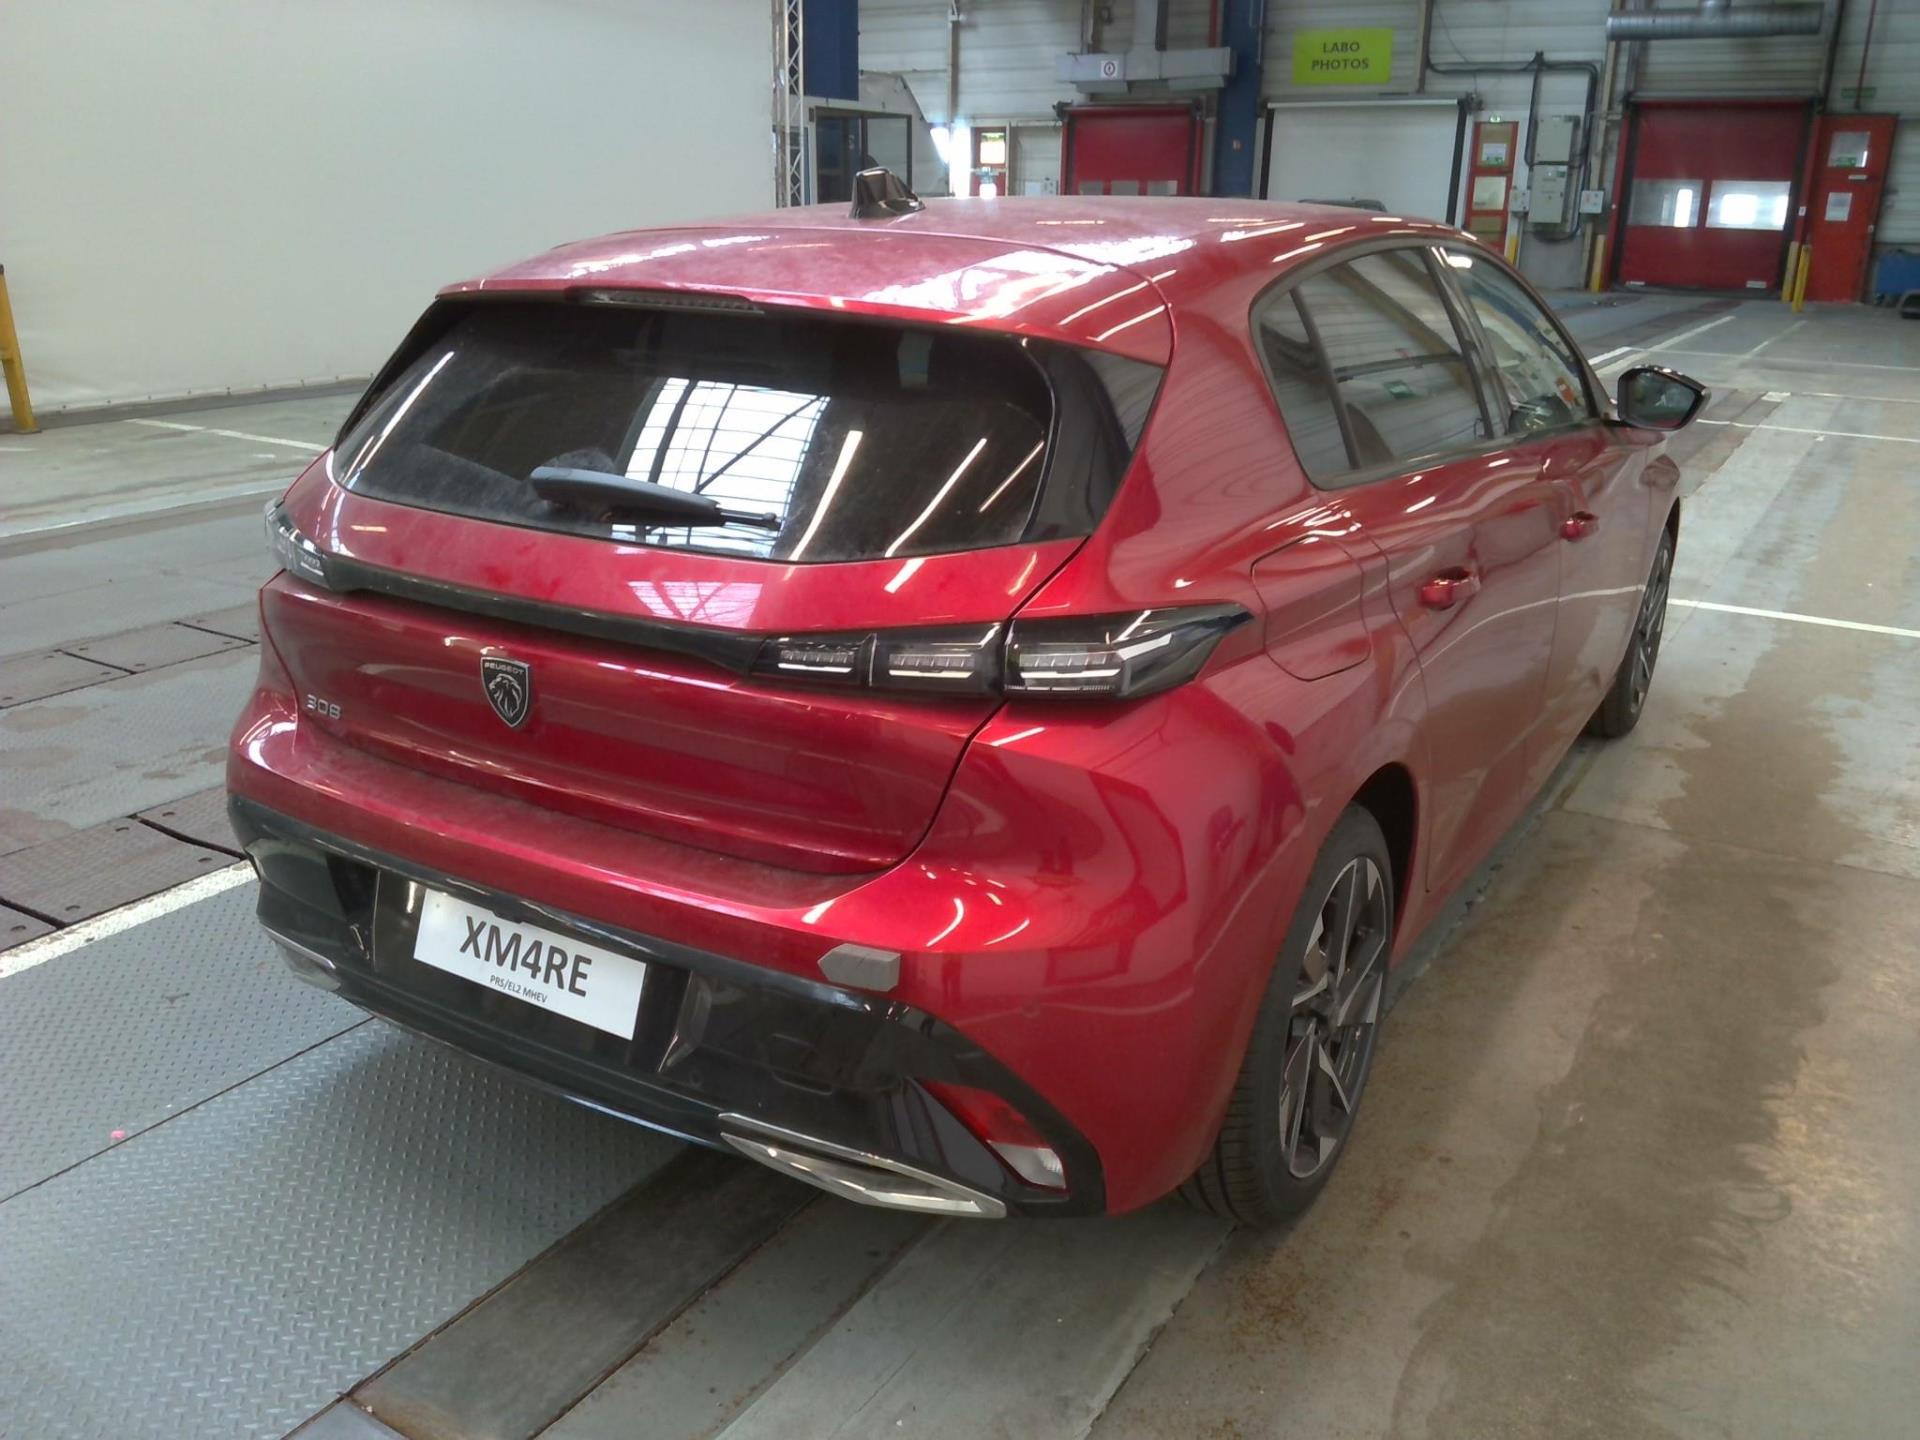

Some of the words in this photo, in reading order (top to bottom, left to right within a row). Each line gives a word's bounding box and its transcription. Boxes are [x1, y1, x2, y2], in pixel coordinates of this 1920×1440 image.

[1323, 41, 1360, 53] LABO
[1312, 57, 1369, 71] PHOTOS
[484, 661, 525, 675] PEUGEOT
[306, 694, 341, 720] 308
[459, 916, 592, 997] XM4RE
[523, 987, 548, 1003] MHEV
